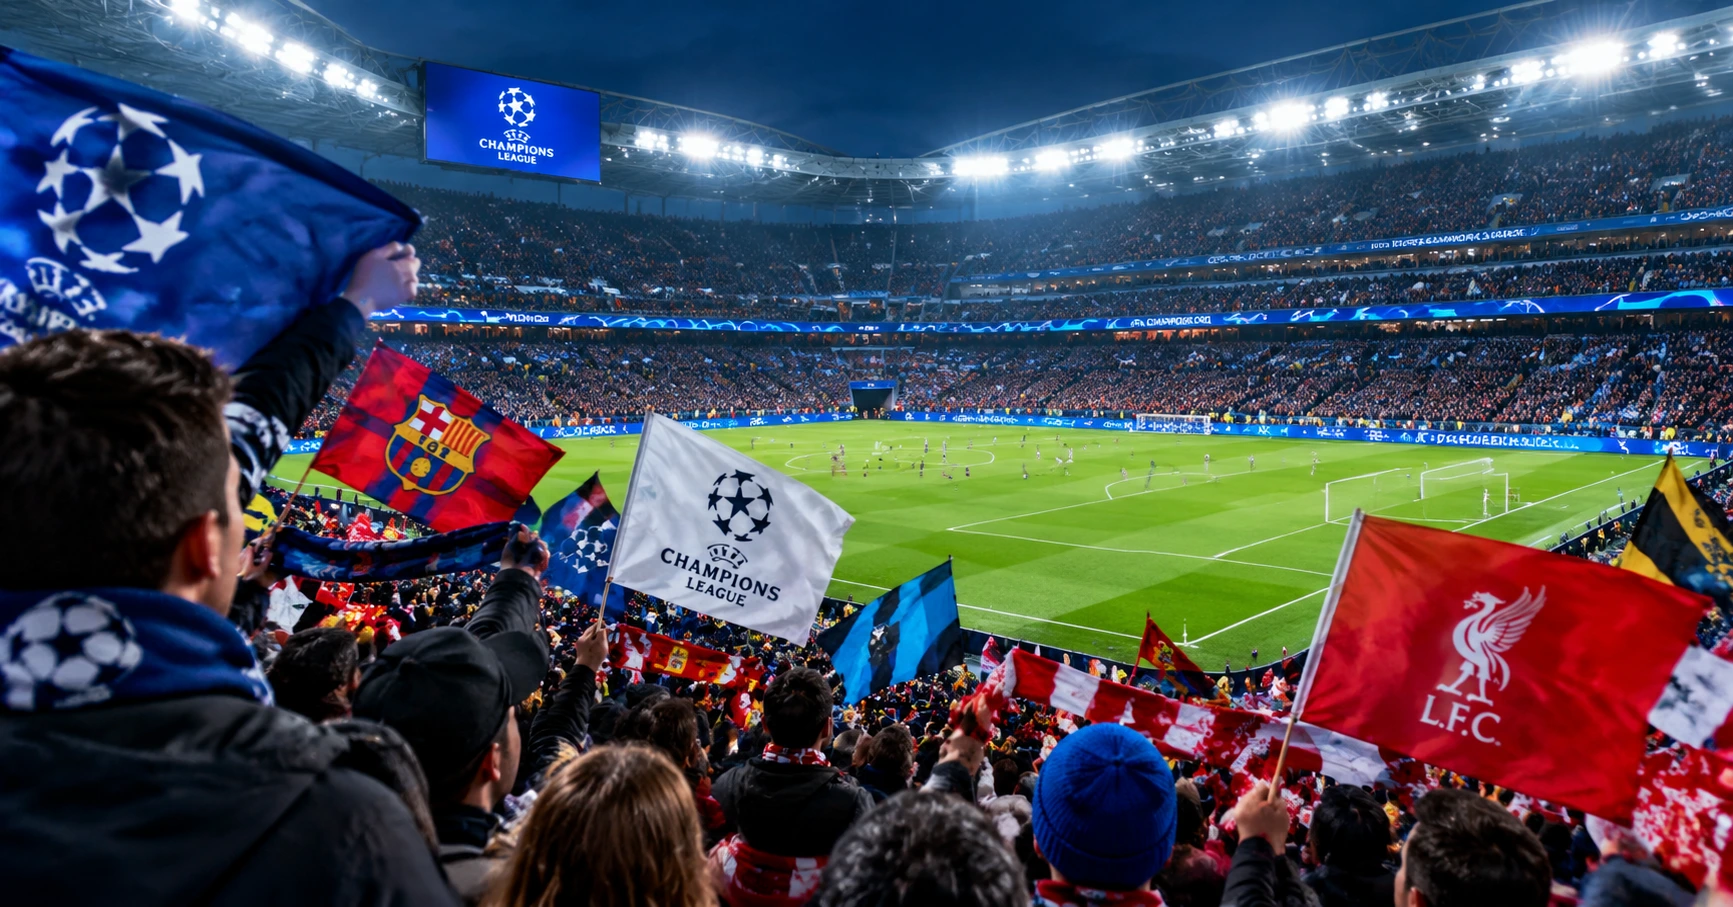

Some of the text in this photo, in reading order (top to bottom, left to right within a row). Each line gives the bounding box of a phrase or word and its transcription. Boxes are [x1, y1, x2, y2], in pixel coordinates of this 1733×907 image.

[479, 138, 554, 157] CHAMPIONS
[498, 152, 537, 164] LEAGUE
[660, 548, 781, 602] CHAMPIONS
[685, 577, 747, 607] LEAGUE
[1419, 694, 1502, 746] L.F.C.
